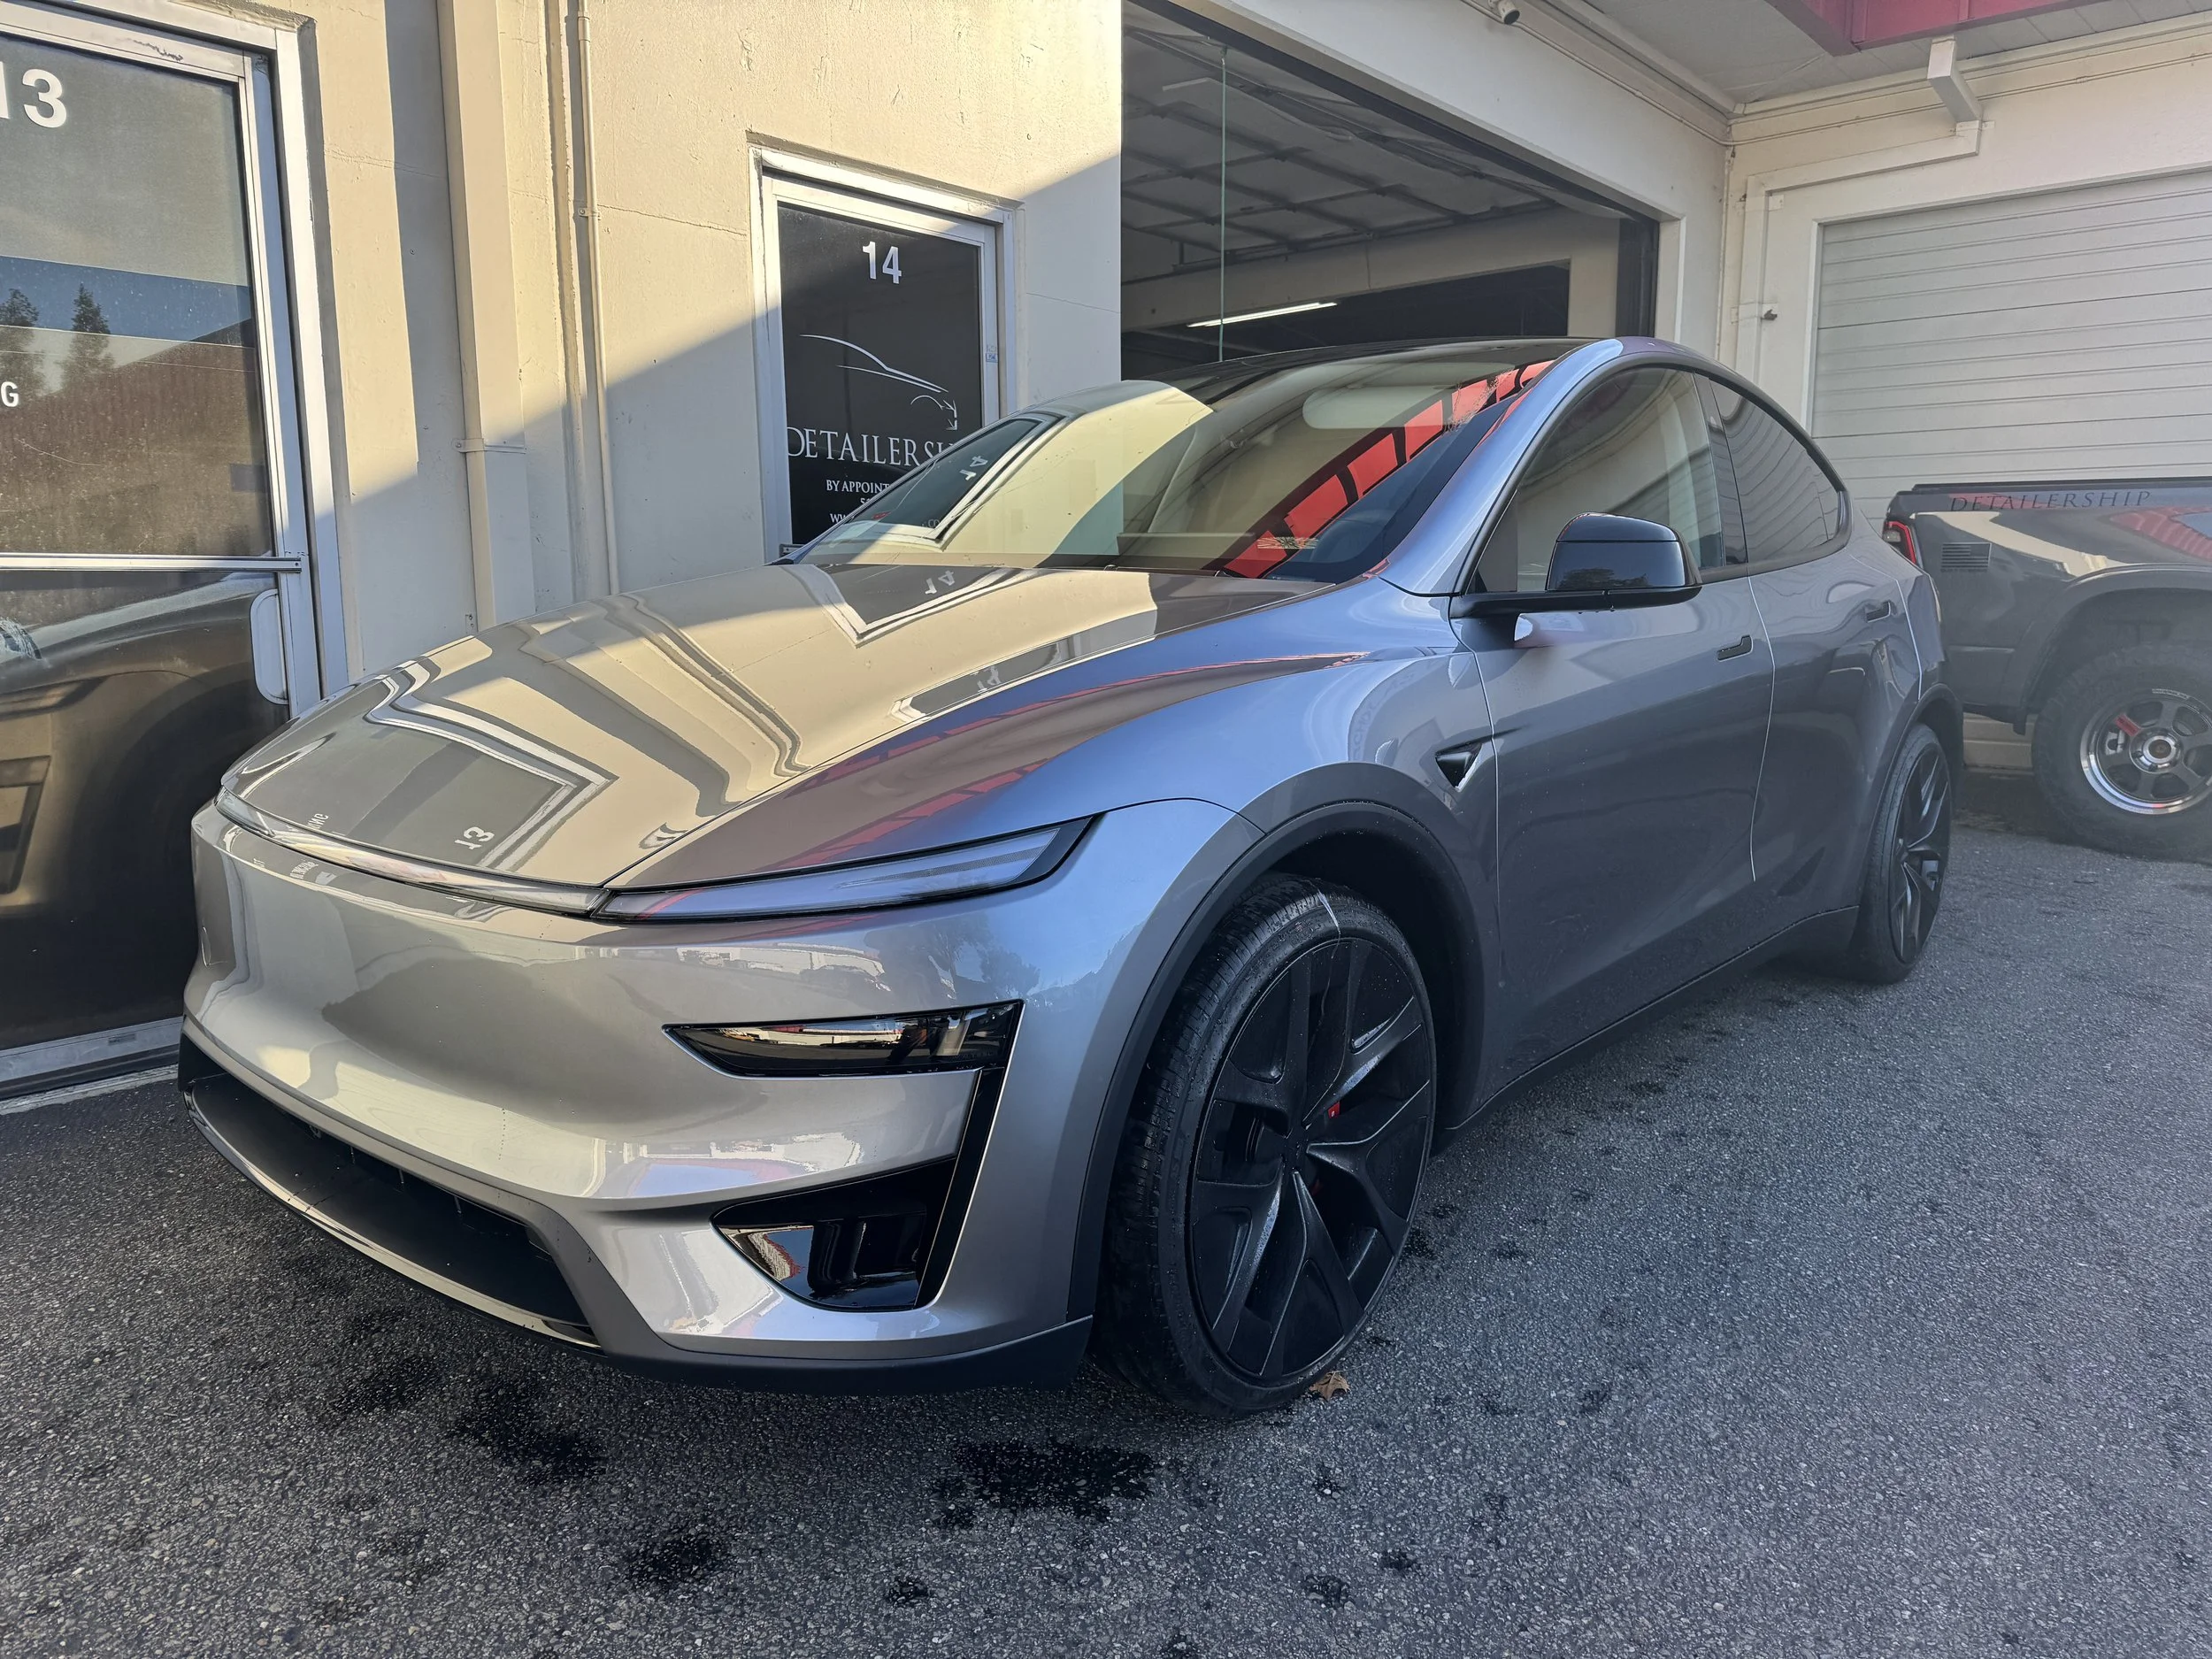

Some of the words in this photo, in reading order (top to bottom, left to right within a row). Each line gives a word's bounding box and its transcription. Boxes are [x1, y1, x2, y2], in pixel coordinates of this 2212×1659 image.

[863, 241, 902, 284] 14
[787, 426, 954, 466] DETAILERS
[826, 480, 840, 492] BY
[1951, 491, 2150, 511] DETAILERSHIP
